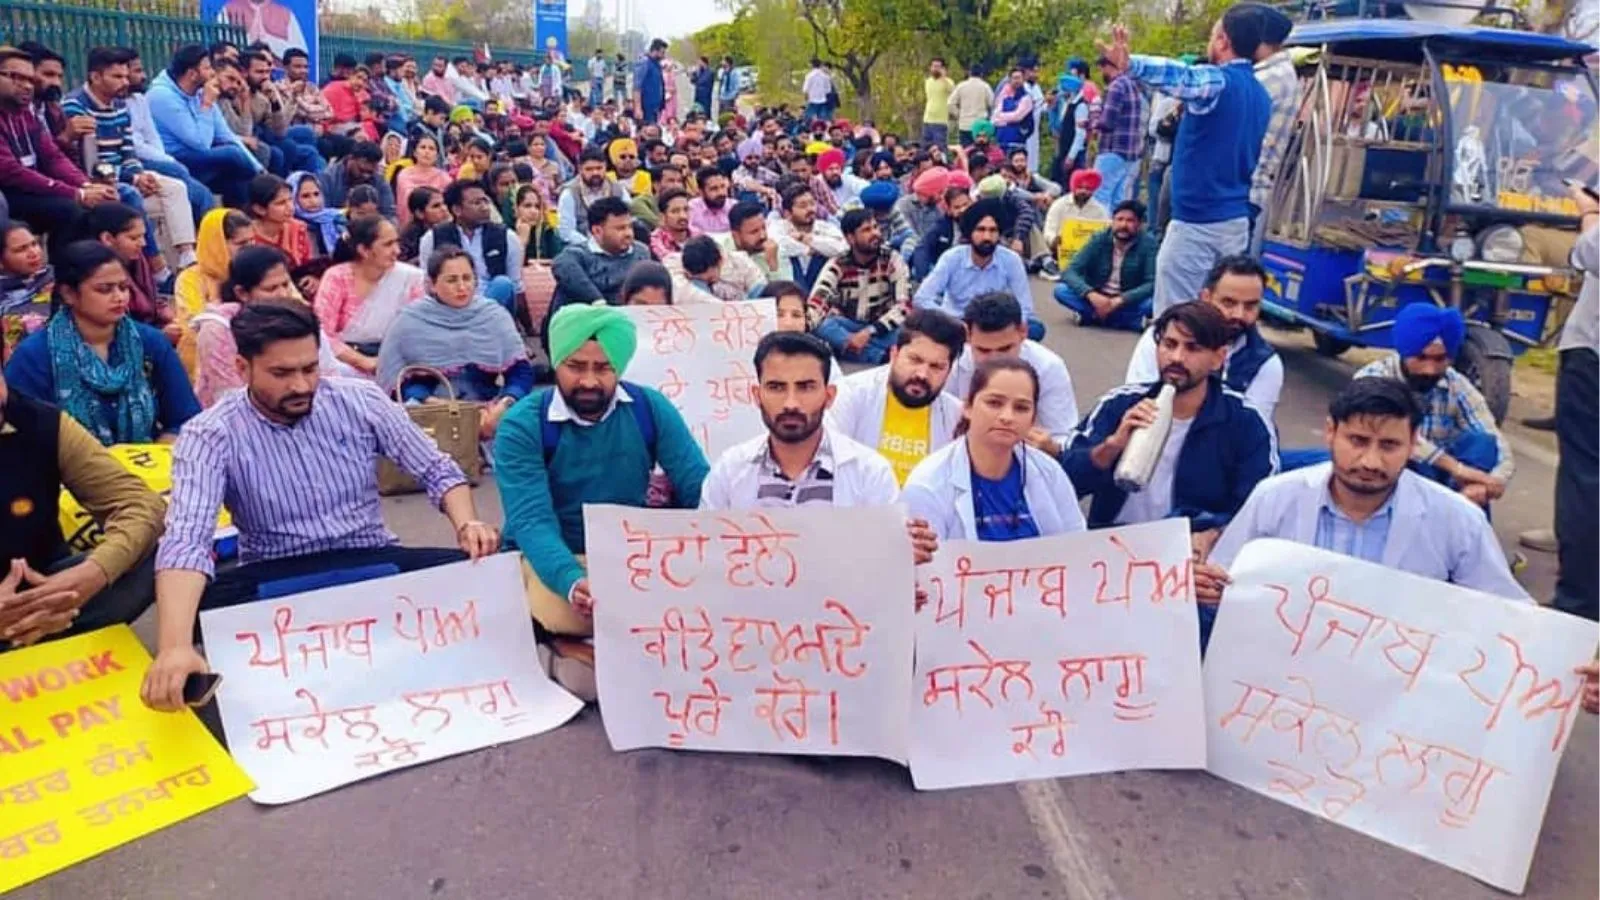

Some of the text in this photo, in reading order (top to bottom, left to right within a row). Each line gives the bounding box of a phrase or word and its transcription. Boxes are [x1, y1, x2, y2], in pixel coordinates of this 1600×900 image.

[622, 514, 799, 591] ਵੋਟਾਂ ਵੇਲੇ
[930, 556, 1068, 629] ਪੰਜਾਬ
[235, 606, 378, 678] ਪੰਜਾਬ
[630, 605, 720, 672] ਕੀਤੇ
[1263, 575, 1440, 692] ਪੰਜਾਬ
[0, 649, 127, 704] WORK
[652, 677, 733, 746] ਪੂਰੇ
[923, 639, 1157, 721] ਸਕੇਲ ਲਾਗੂ
[48, 694, 122, 739] PAY
[250, 680, 528, 753] ਸਕੇਲ ਲਾਗੂ
[1375, 729, 1511, 829] ਲਾਗੂ
